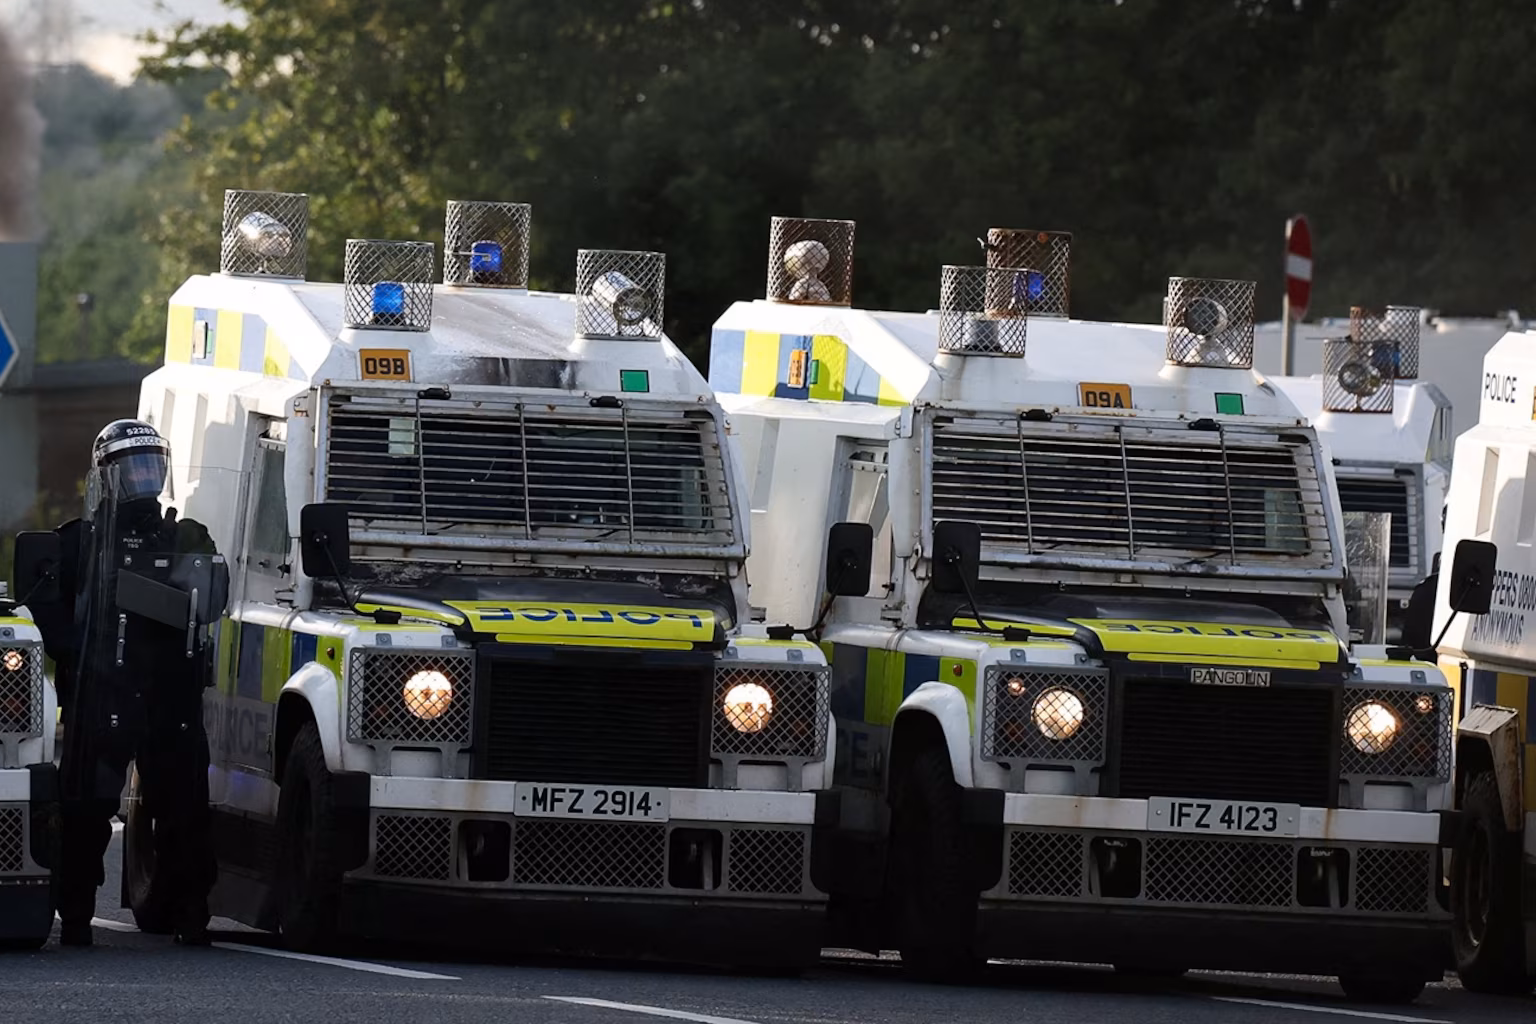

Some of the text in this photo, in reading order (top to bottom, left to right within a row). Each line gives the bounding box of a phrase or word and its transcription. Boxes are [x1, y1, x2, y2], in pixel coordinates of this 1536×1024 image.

[364, 357, 405, 375] 09B
[1484, 372, 1517, 404] POLICE
[1085, 390, 1124, 409] 09A
[475, 607, 703, 629] POLICE
[1100, 623, 1326, 643] POLICE
[1193, 670, 1268, 686] PANGOLIN
[531, 787, 652, 817] MFZ 2914
[1169, 802, 1278, 832] IFZ 4123
